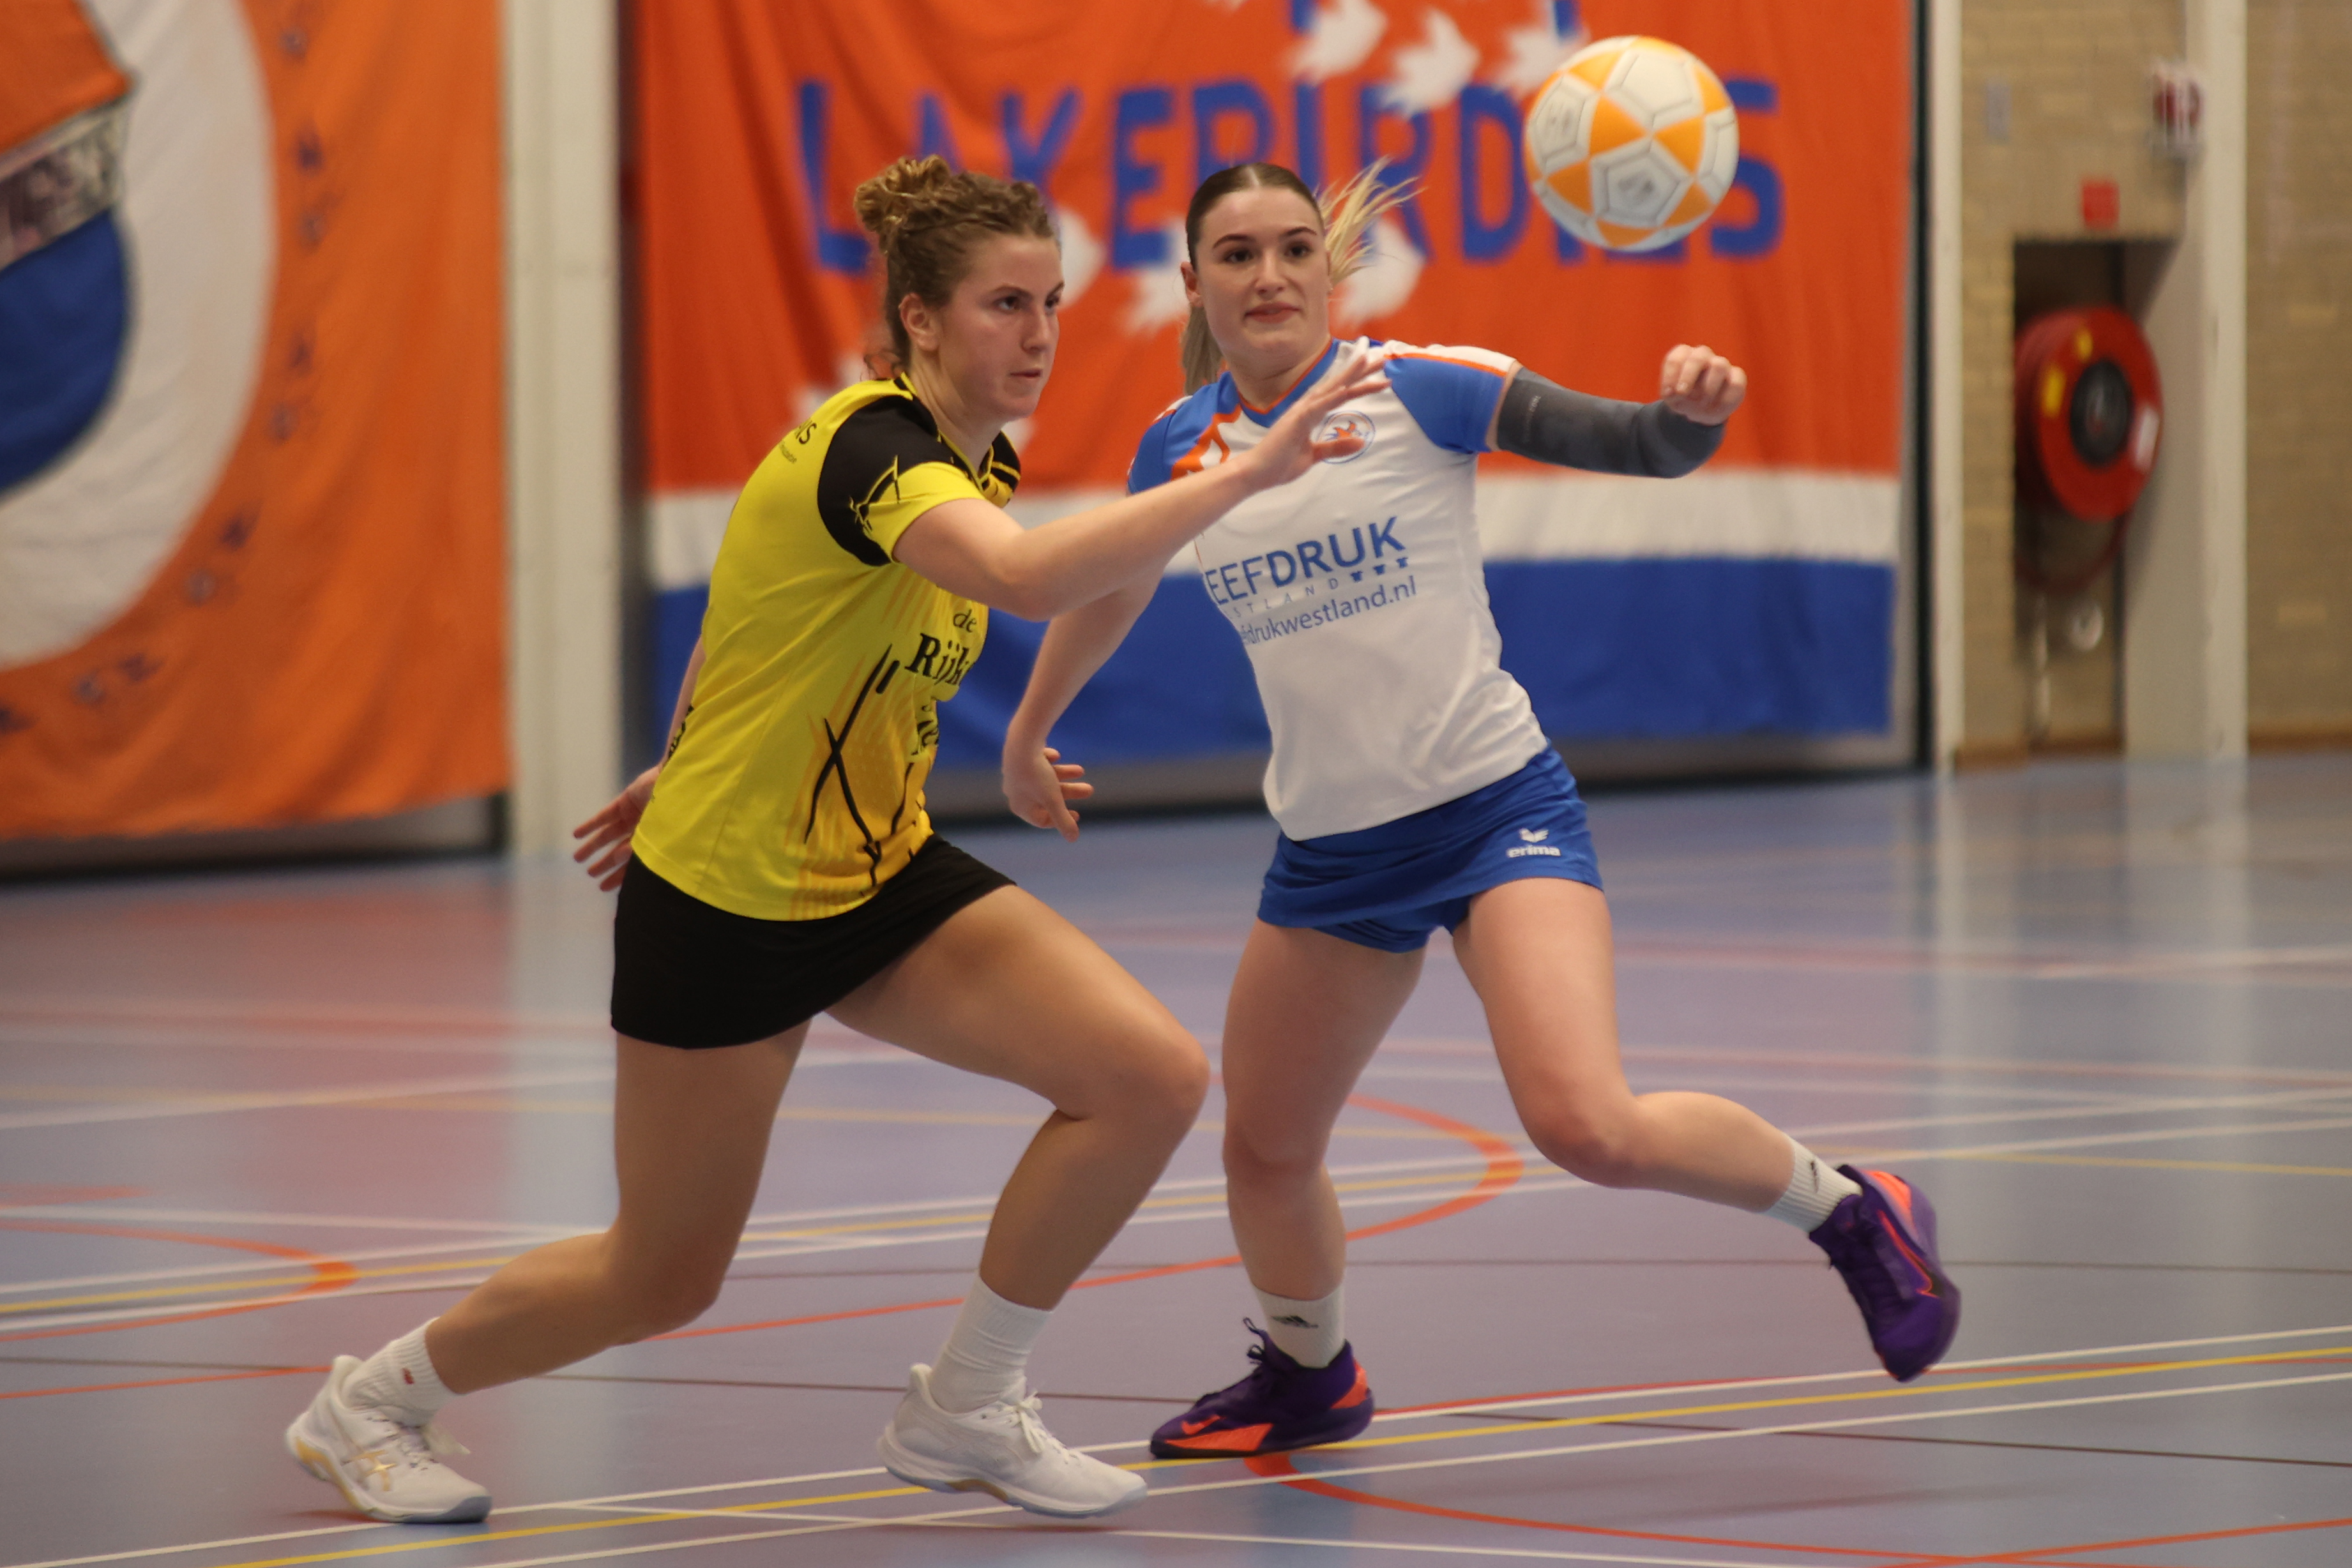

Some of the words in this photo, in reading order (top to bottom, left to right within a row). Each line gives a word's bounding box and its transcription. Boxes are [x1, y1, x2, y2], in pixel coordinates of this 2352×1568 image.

[798, 77, 1784, 276] LKEBIRDS
[1205, 516, 1406, 605] EEFDRUK
[953, 608, 977, 633] de
[1224, 578, 1339, 619] STLAND
[1240, 575, 1416, 644] drukwestland.nl
[1507, 844, 1561, 858] erima
